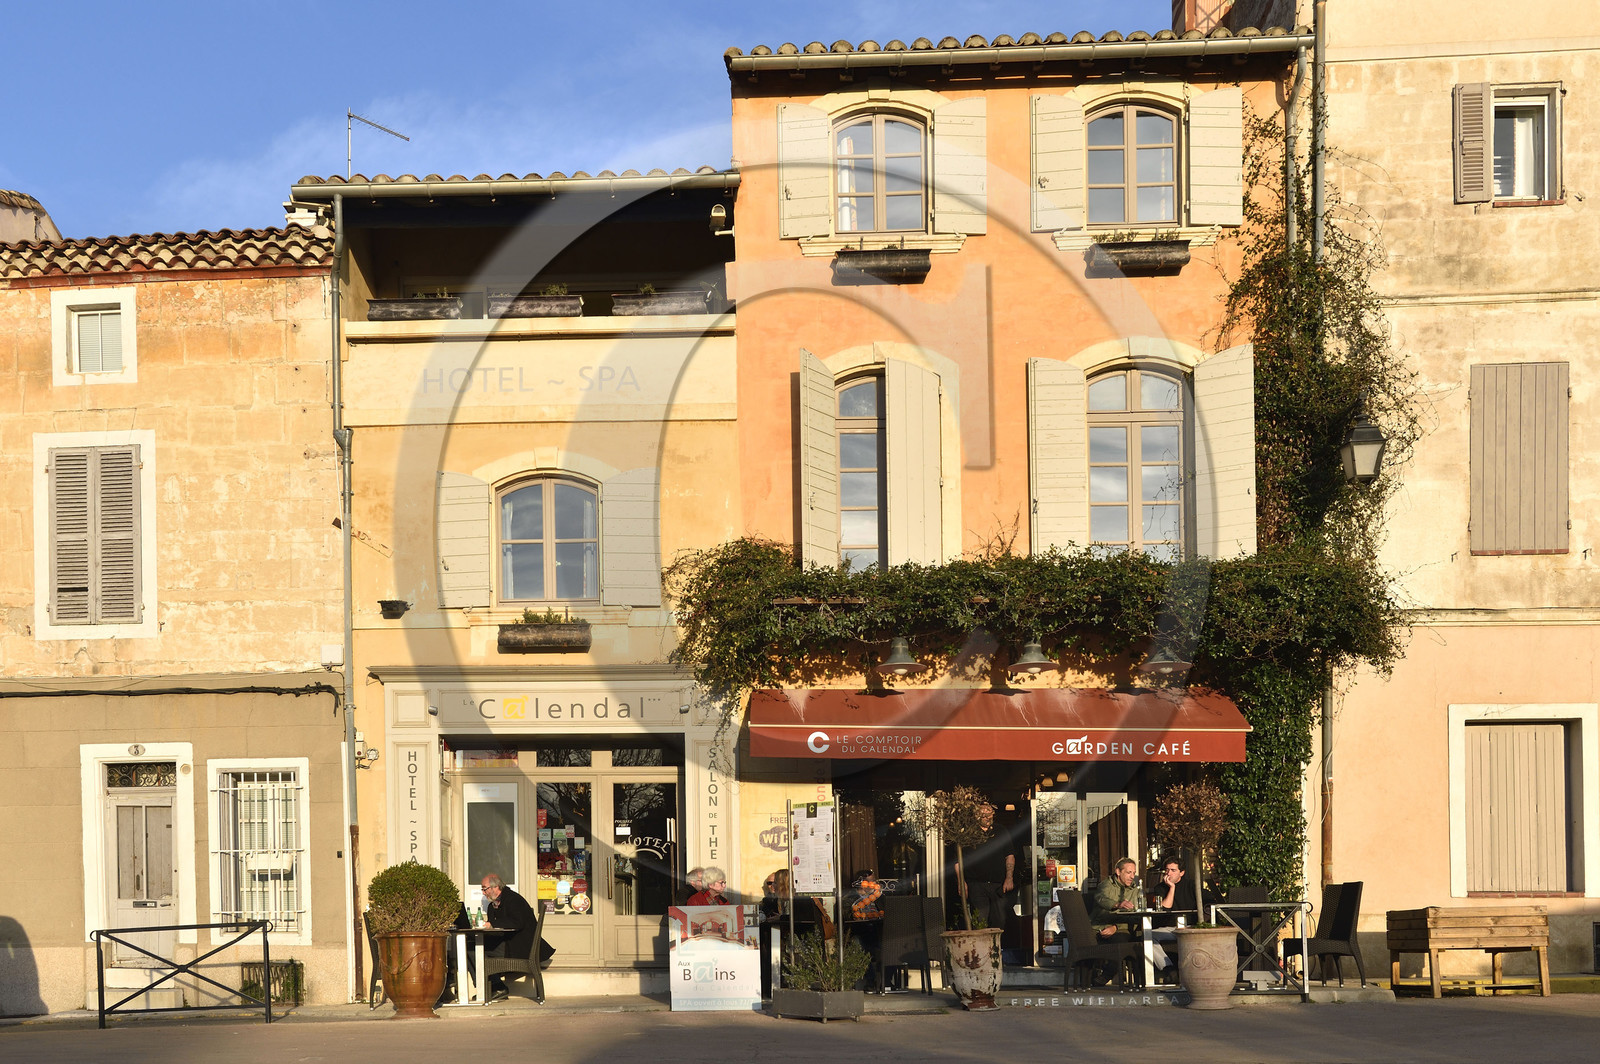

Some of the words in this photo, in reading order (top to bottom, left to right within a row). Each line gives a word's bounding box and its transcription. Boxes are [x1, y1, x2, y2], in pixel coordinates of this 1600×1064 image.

[423, 366, 533, 393] HOTEL
[578, 365, 641, 393] SPA
[478, 695, 644, 720] Calendal
[836, 735, 850, 745] LE
[855, 735, 922, 744] COMPTOIR
[841, 745, 856, 753] DU
[860, 745, 917, 754] CALENDAL
[1144, 740, 1191, 756] CAFÉ
[407, 750, 418, 811] HOTEL
[708, 747, 718, 807] SALON
[409, 830, 419, 864] SPA
[709, 825, 718, 860] THE
[683, 961, 736, 983] Bains
[1011, 997, 1060, 1007] FREE
[1072, 996, 1115, 1006] WIFI
[1128, 995, 1179, 1006] AREA
